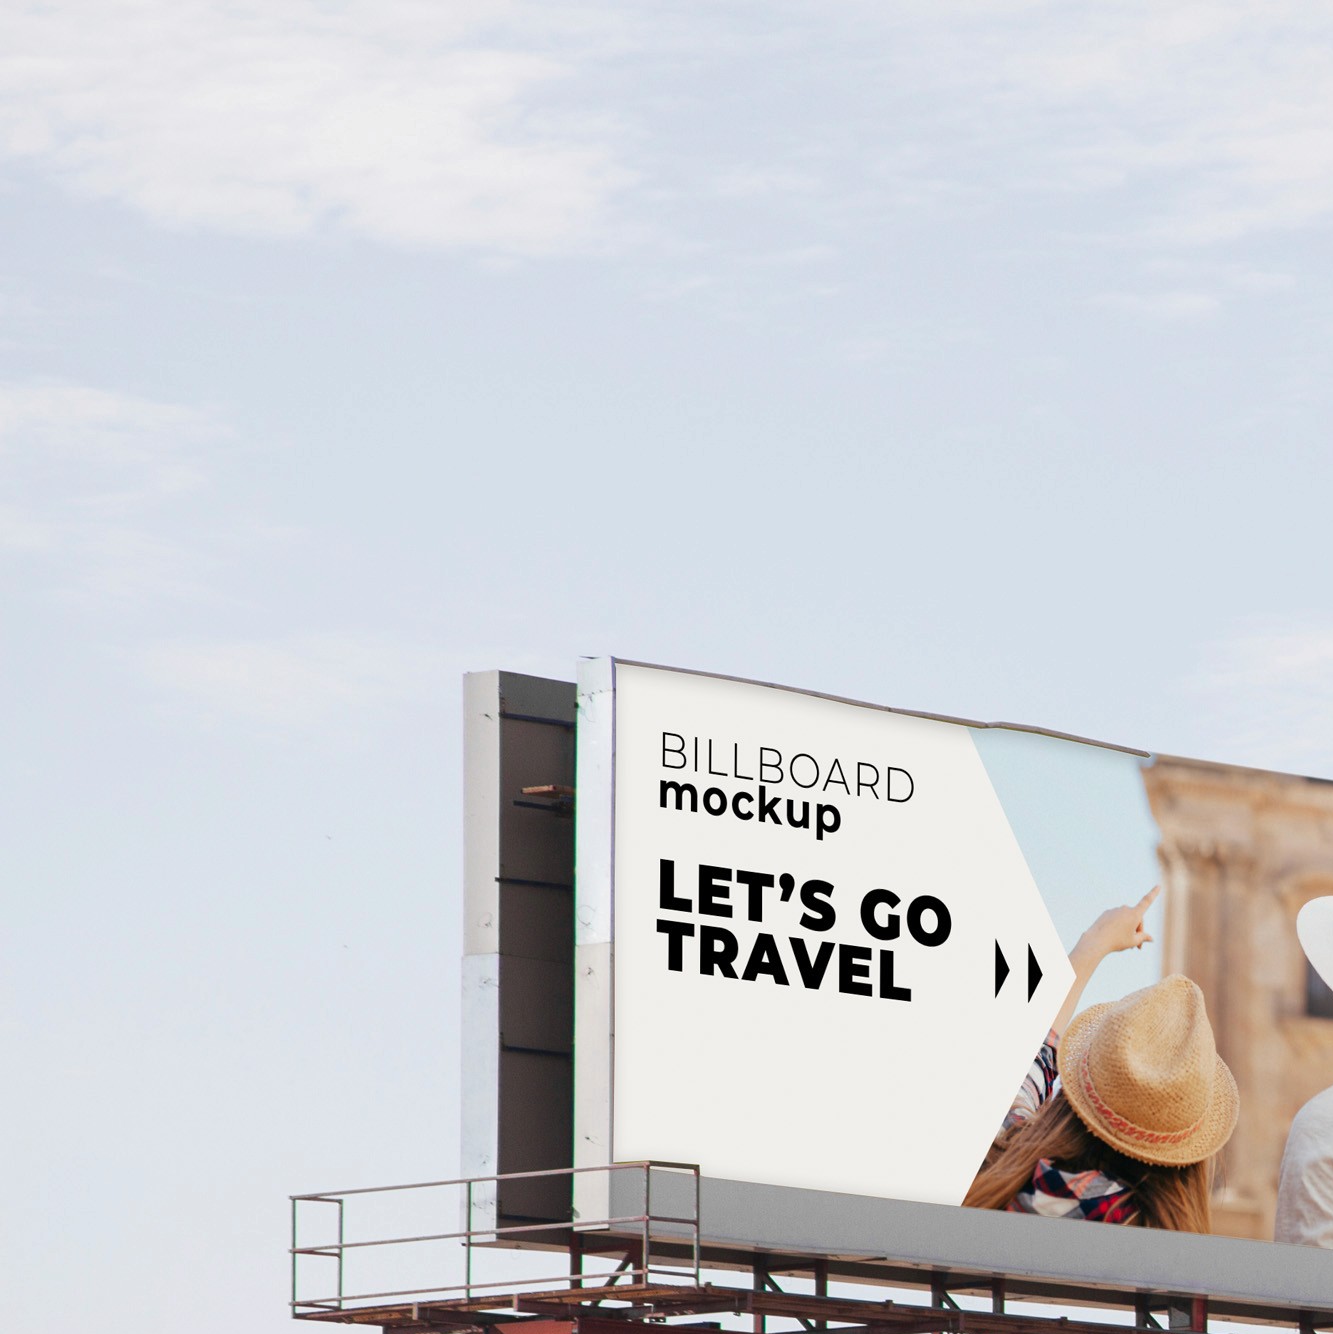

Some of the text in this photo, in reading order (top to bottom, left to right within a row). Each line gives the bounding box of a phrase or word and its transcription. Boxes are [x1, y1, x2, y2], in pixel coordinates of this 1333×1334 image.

[661, 731, 915, 803] BILLBOARD
[659, 779, 842, 841] mockup
[659, 858, 952, 948] LET'S GO
[656, 918, 912, 1003] TRAVEL
